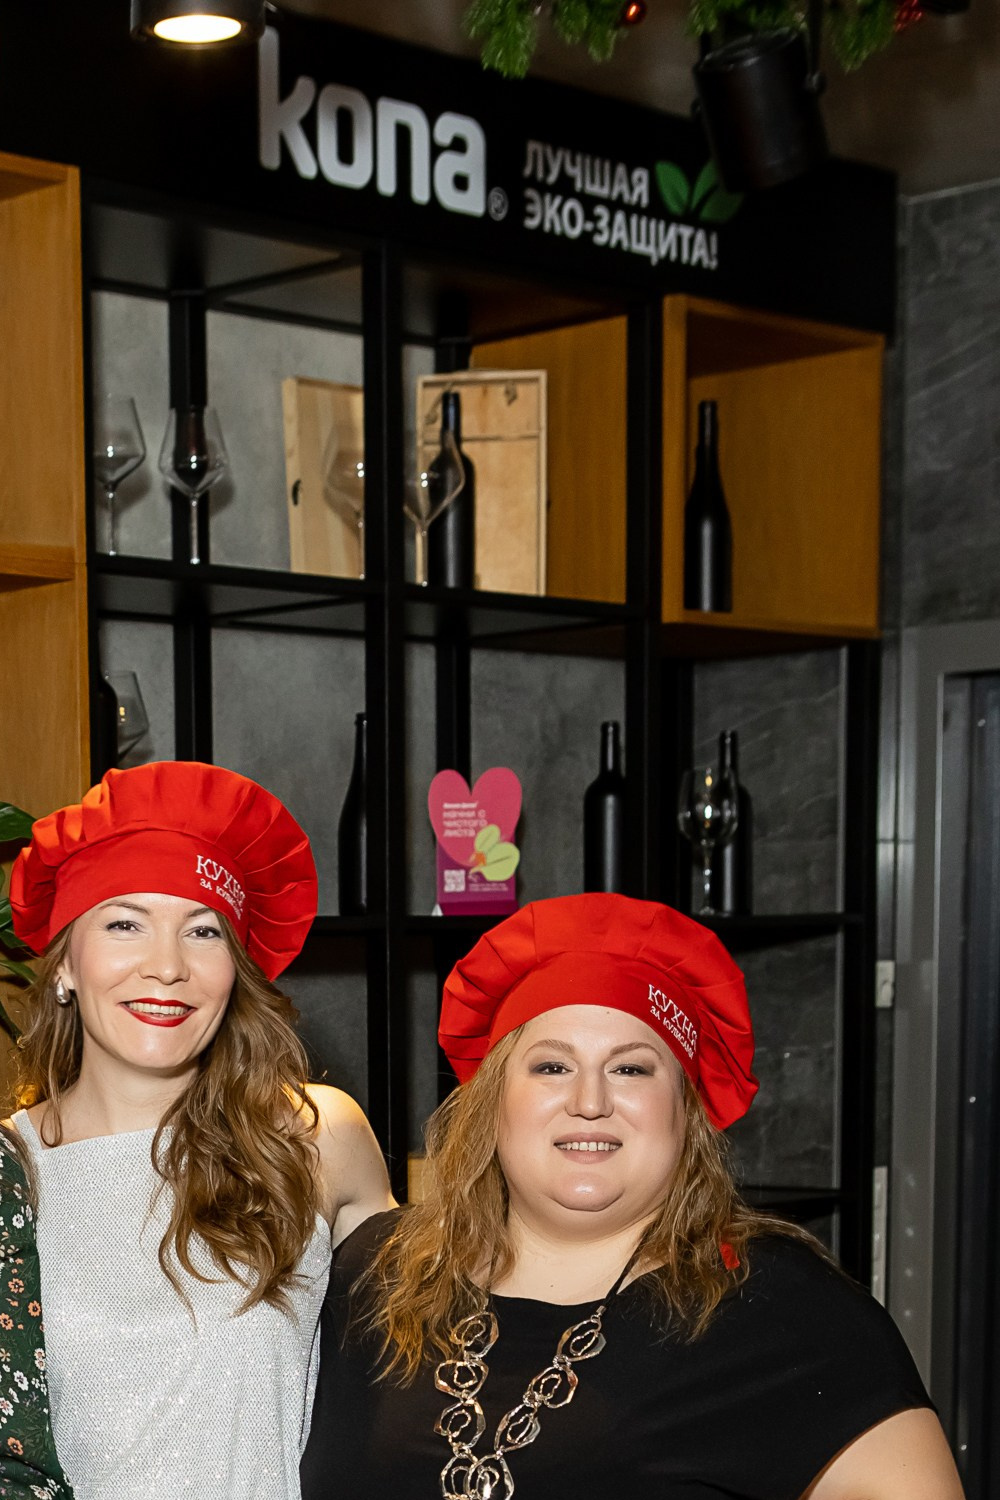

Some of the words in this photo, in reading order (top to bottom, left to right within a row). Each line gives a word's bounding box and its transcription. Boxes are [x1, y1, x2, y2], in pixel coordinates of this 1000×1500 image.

[523, 140, 650, 208] ЛУЧШАЯ
[523, 191, 718, 271] ЭКО-ЗАЩИТА!
[648, 983, 698, 1052] КУХНЯ
[649, 1005, 660, 1020] ЗА
